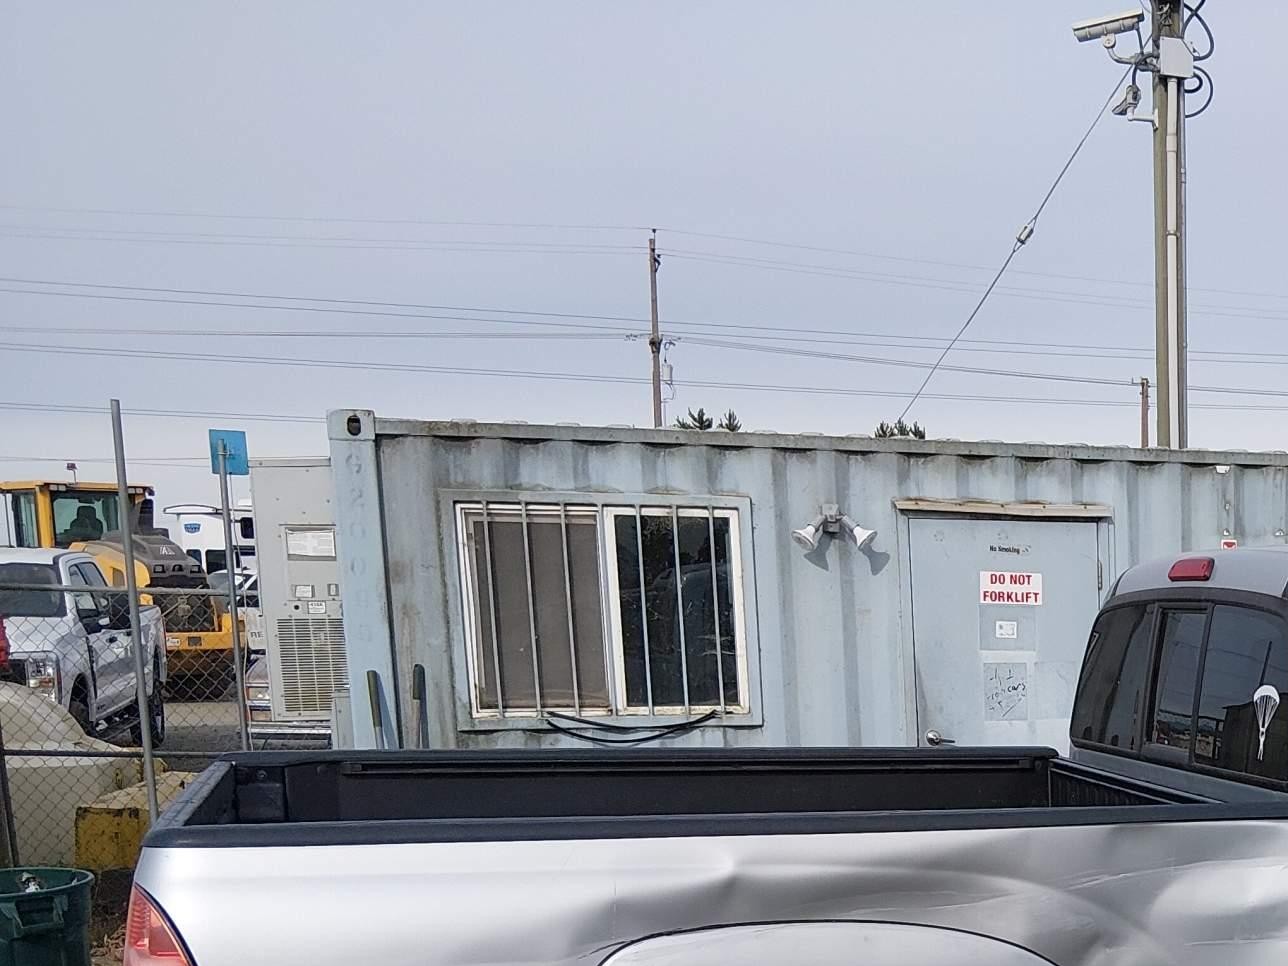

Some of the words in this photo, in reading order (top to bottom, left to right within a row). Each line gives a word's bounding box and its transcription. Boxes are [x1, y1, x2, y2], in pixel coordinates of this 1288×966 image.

[998, 545, 1020, 555] Smoking
[990, 573, 1005, 585] DO
[1009, 574, 1032, 586] NOT
[983, 590, 1040, 603] FORKLIFT
